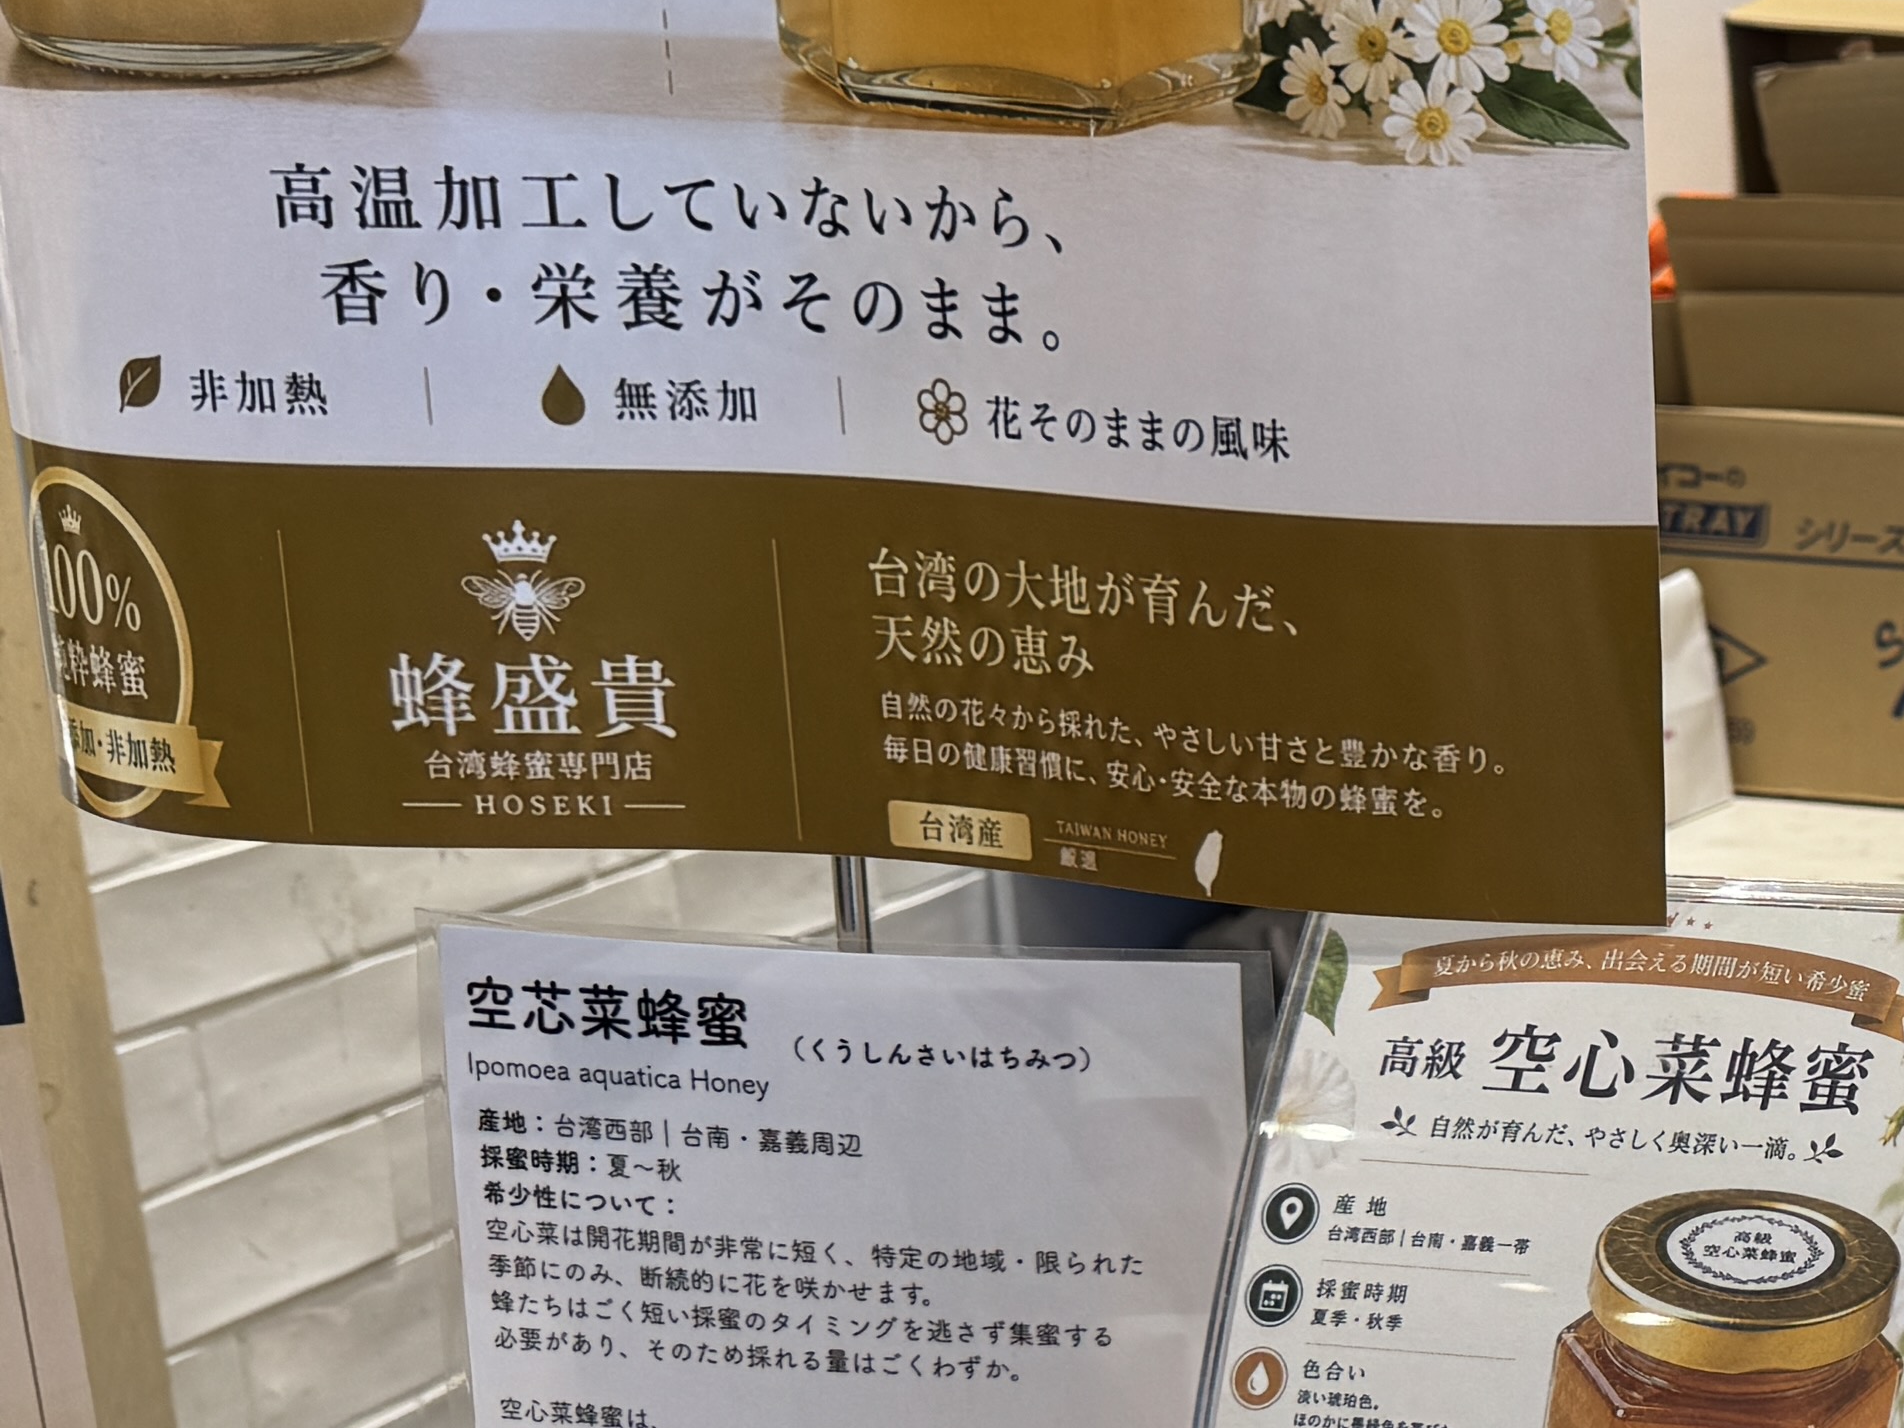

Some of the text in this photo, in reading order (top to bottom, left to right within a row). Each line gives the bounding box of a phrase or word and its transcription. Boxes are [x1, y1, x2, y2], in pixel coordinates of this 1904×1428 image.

[270, 160, 1070, 255] 高温加工していないから、
[323, 261, 1066, 355] 香り・栄養がそのまま。
[189, 370, 329, 417] 非加熱
[612, 375, 758, 424] 無添加
[985, 393, 1291, 465] 花そのままの風味
[868, 548, 1298, 637] 台湾の大地が育んだ、
[874, 615, 1094, 679] 天然の恵み
[390, 652, 676, 739] 蜂盛貴
[476, 795, 613, 817] HOSEKI
[920, 811, 1004, 848] 台湾産
[1056, 820, 1168, 848] TAIWAN HONEY
[467, 978, 749, 1049] 空芯菜蜂蜜
[468, 1051, 769, 1101] Ipomoea aquatica Honey
[1378, 1023, 1876, 1116] 高級 空心菜蜂蜜
[1429, 1114, 1801, 1163] 自然が育んだ、やさしく奥深い一滴。
[488, 1253, 933, 1308] 季節にのみ、断続的に花を咲かせます。
[1316, 1278, 1408, 1304] 採蜜時期
[491, 1291, 1113, 1348] 蜂たちはごく短い採蜜のタイミングを逃さず集蜜する
[1310, 1308, 1403, 1331] 夏季・秋季
[494, 1326, 1021, 1382] 必要があり、そのため採れる量はごくわずか。
[1302, 1359, 1366, 1381] 色合い
